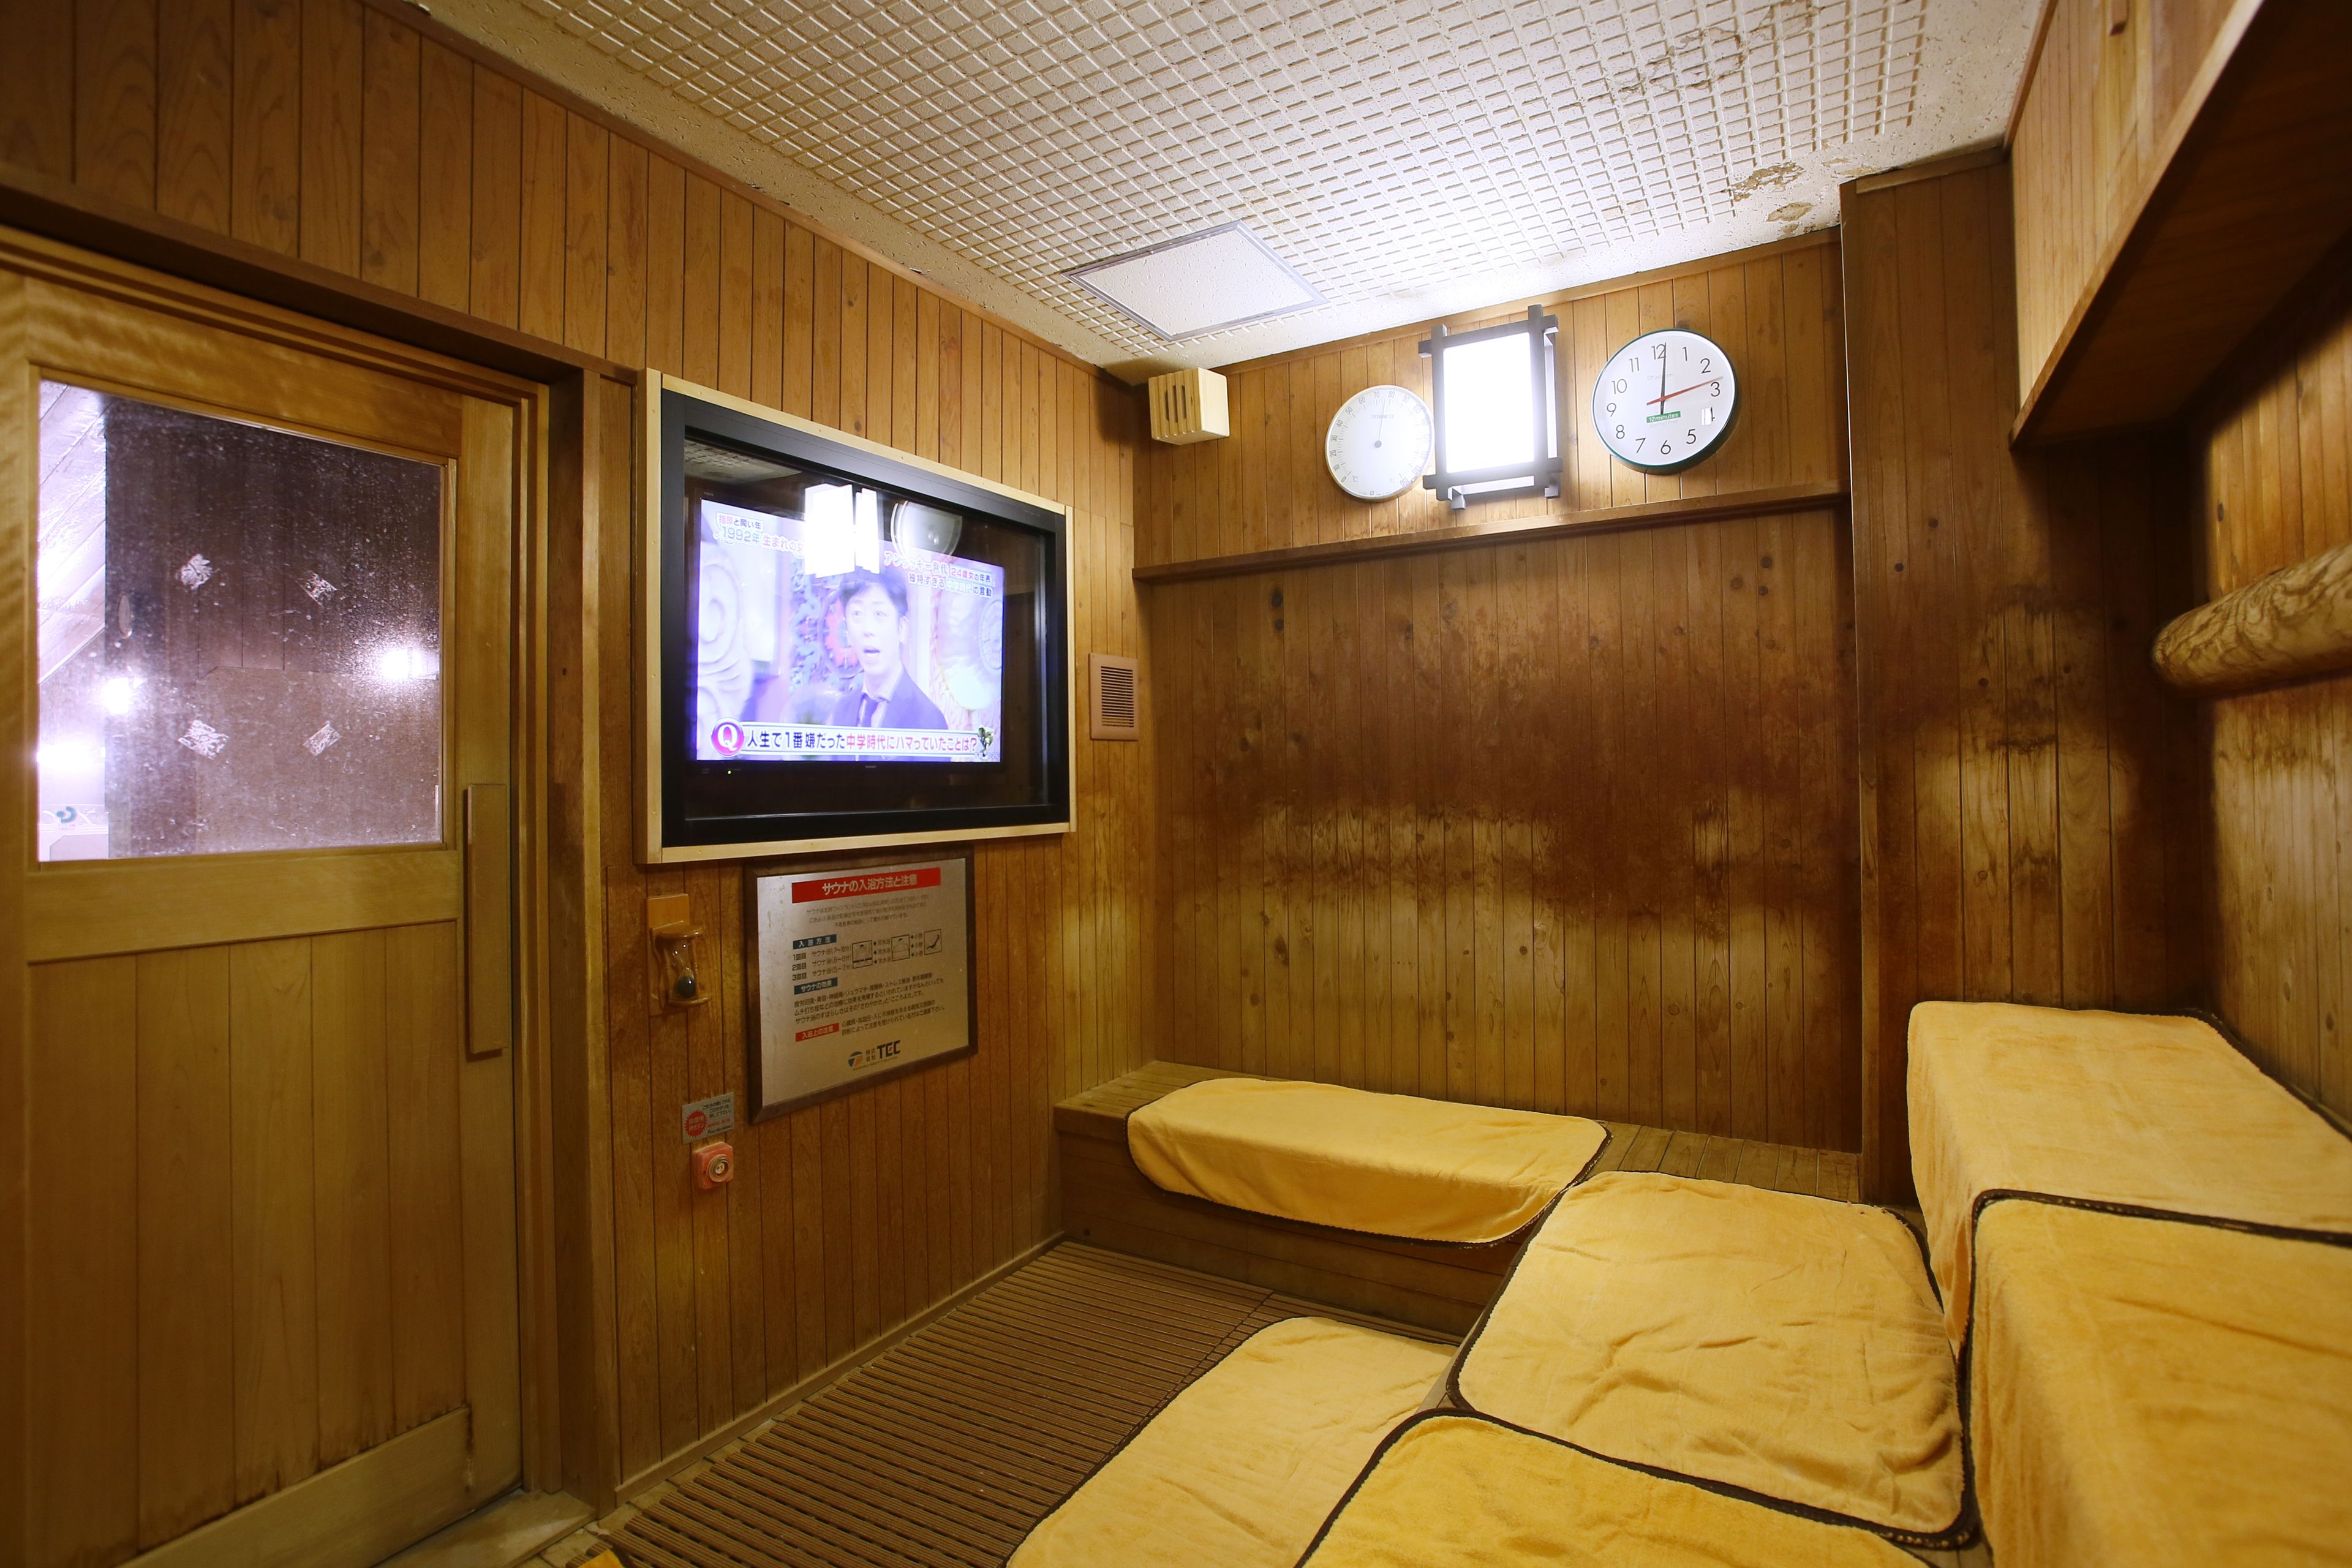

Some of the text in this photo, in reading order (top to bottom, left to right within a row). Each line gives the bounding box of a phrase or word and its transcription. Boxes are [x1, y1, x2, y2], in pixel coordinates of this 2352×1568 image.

[1651, 344, 1666, 360] 12
[1682, 347, 1688, 361] 1
[1629, 357, 1640, 372] 11
[1700, 358, 1711, 374] 2
[1611, 379, 1628, 394] 10
[1710, 382, 1721, 397] 3
[1345, 406, 1353, 415] 50
[1607, 402, 1617, 417] 9
[1649, 412, 1679, 422] 12minutes
[1336, 419, 1343, 428] 40
[1615, 424, 1625, 439] 8
[1686, 429, 1697, 445] 5
[1635, 437, 1646, 454] 7
[1660, 440, 1672, 454] 6
[717, 724, 737, 752] Q
[876, 1039, 901, 1059] TEC
